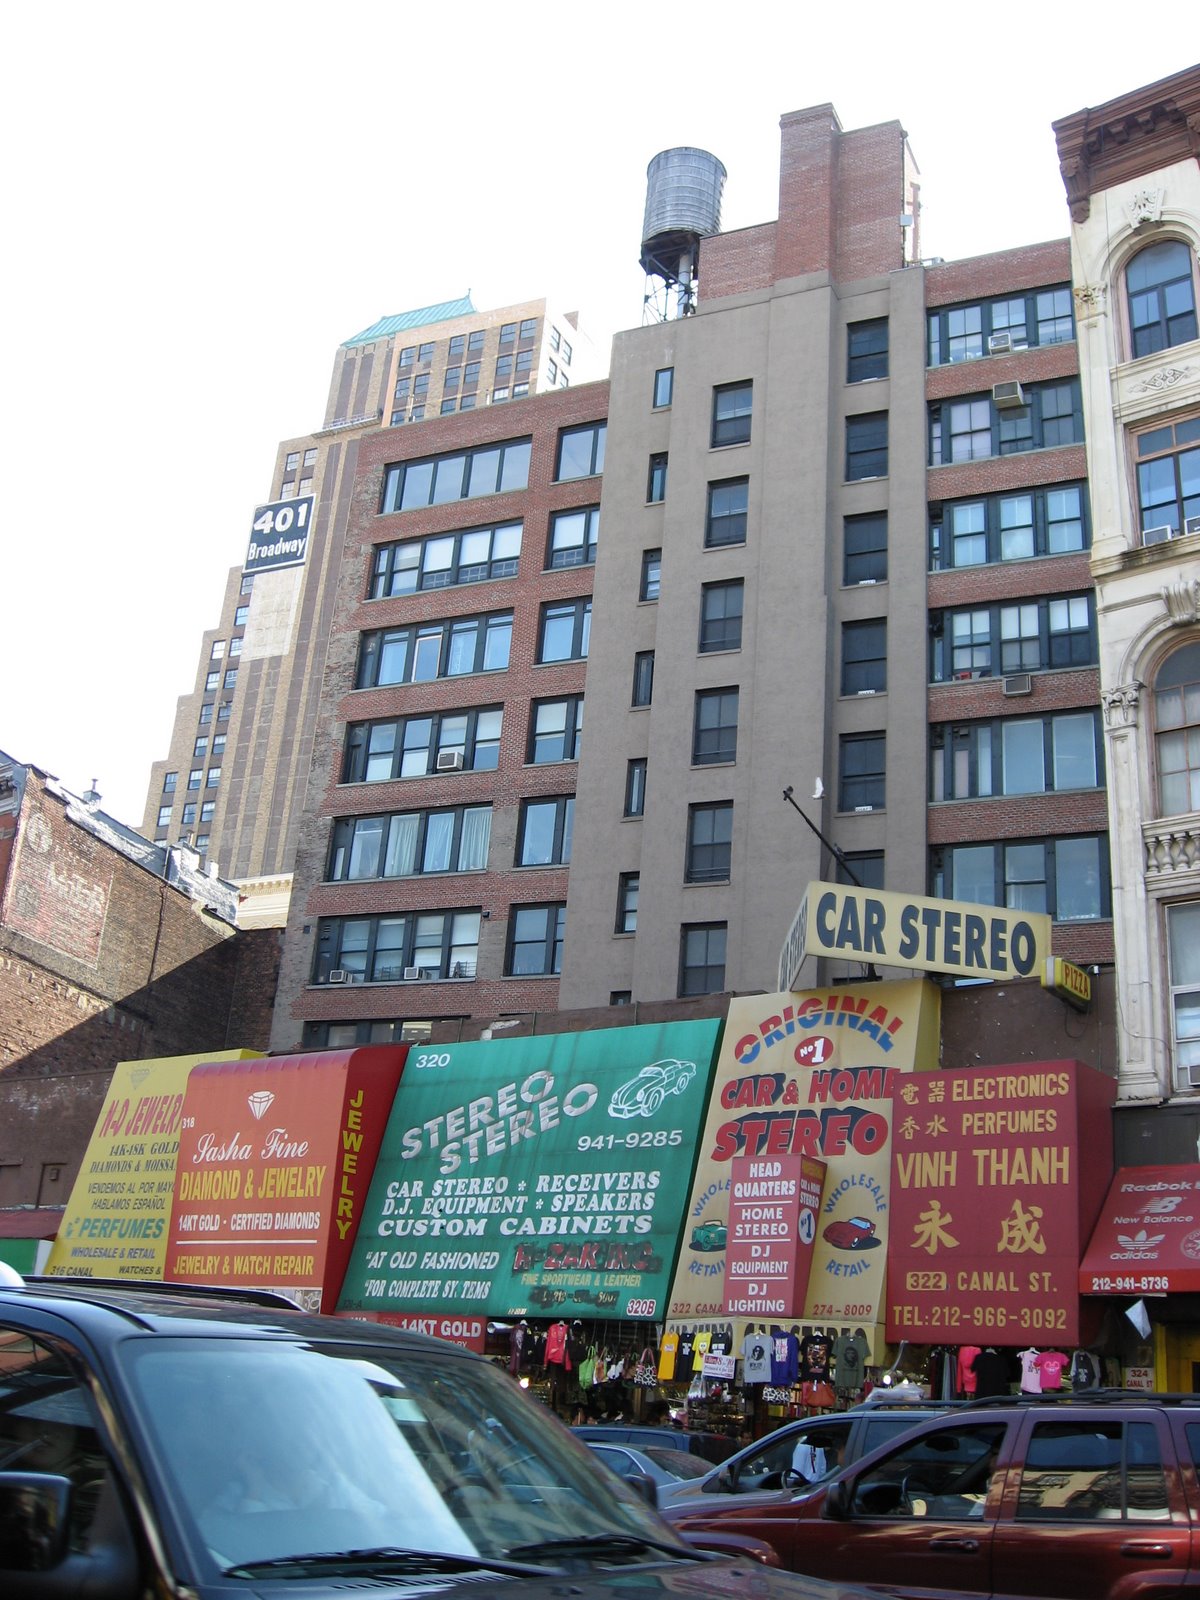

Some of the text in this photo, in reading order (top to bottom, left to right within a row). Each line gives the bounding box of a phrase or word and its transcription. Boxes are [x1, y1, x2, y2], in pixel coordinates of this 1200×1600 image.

[253, 503, 308, 534] 401
[248, 537, 306, 560] Broadway
[816, 891, 1037, 976] CAR STEREO
[1064, 963, 1089, 998] PIZZA
[735, 995, 903, 1065] ORIGINAL
[415, 1053, 451, 1069] 320
[720, 1068, 900, 1109] CAR & HOME
[952, 1073, 1070, 1102] ELECTRONICS
[182, 1117, 196, 1129] 318
[401, 1070, 555, 1160] STEREO
[962, 1109, 1057, 1136] PERFUMES
[439, 1083, 598, 1175] STEREO
[710, 1111, 889, 1162] STEREO
[898, 1114, 949, 1140] 香水
[150, 1141, 180, 1155] GOLD
[192, 1128, 309, 1164] Sasha Fine
[577, 1130, 684, 1152] 941-9285
[90, 1159, 176, 1174] DIAMONDS & MOISSA
[336, 1089, 364, 1241] JEWELRY
[750, 1162, 782, 1178] HEAD
[897, 1146, 1070, 1188] VINH THANH
[88, 1183, 126, 1195] VENDEMOS
[127, 1183, 136, 1194] AL
[139, 1182, 154, 1194] POR
[179, 1165, 327, 1201] DIAMOND & JEWELRY
[386, 1171, 661, 1199] CAR STEREO RECEIVERS
[734, 1180, 796, 1198] QUARTERS
[800, 1192, 819, 1209] STEREO
[823, 1173, 887, 1213] WHOLESALE
[91, 1195, 166, 1211] HABLAMOS ESPAÑOL
[381, 1192, 656, 1218] D.J. EQUIPMENT SPEAKERS
[179, 1211, 321, 1232] 14KT GOLD CERTIFIED DIAMONDS
[742, 1207, 784, 1221] HOME
[1143, 1215, 1194, 1224] Balance
[79, 1217, 166, 1239] PERFUMES
[377, 1215, 653, 1237] CUSTOM CABINETS
[735, 1223, 789, 1236] STEREO
[71, 1247, 156, 1259] WHOLESALE & RETAIL
[389, 1252, 418, 1270] OLD
[420, 1251, 499, 1270] FASHIONED
[751, 1245, 771, 1258] DJ
[1110, 1251, 1159, 1260] adidas
[67, 1266, 93, 1277] CANAL
[118, 1266, 161, 1275] WATCHES &
[173, 1255, 314, 1276] JEWELRY & WATCH REPAIR
[731, 1261, 789, 1274] EQUIPMENT
[826, 1259, 871, 1278] RETAIL
[388, 1279, 442, 1299] COMPLETE
[442, 1280, 491, 1299] SYTEMS
[541, 1273, 592, 1286] SPORTWEAR
[604, 1274, 642, 1287] LEATHER
[748, 1283, 768, 1296] DJ
[909, 1272, 1058, 1292] 322 CANAL ST.
[1092, 1276, 1169, 1290] 212-941-8736
[627, 1299, 656, 1316] 320B
[672, 1303, 691, 1314] 322
[728, 1299, 785, 1312] LIGHTING
[813, 1304, 872, 1316] 274-8009
[401, 1318, 482, 1337] 14KT GOLD
[1130, 1369, 1148, 1378] 324
